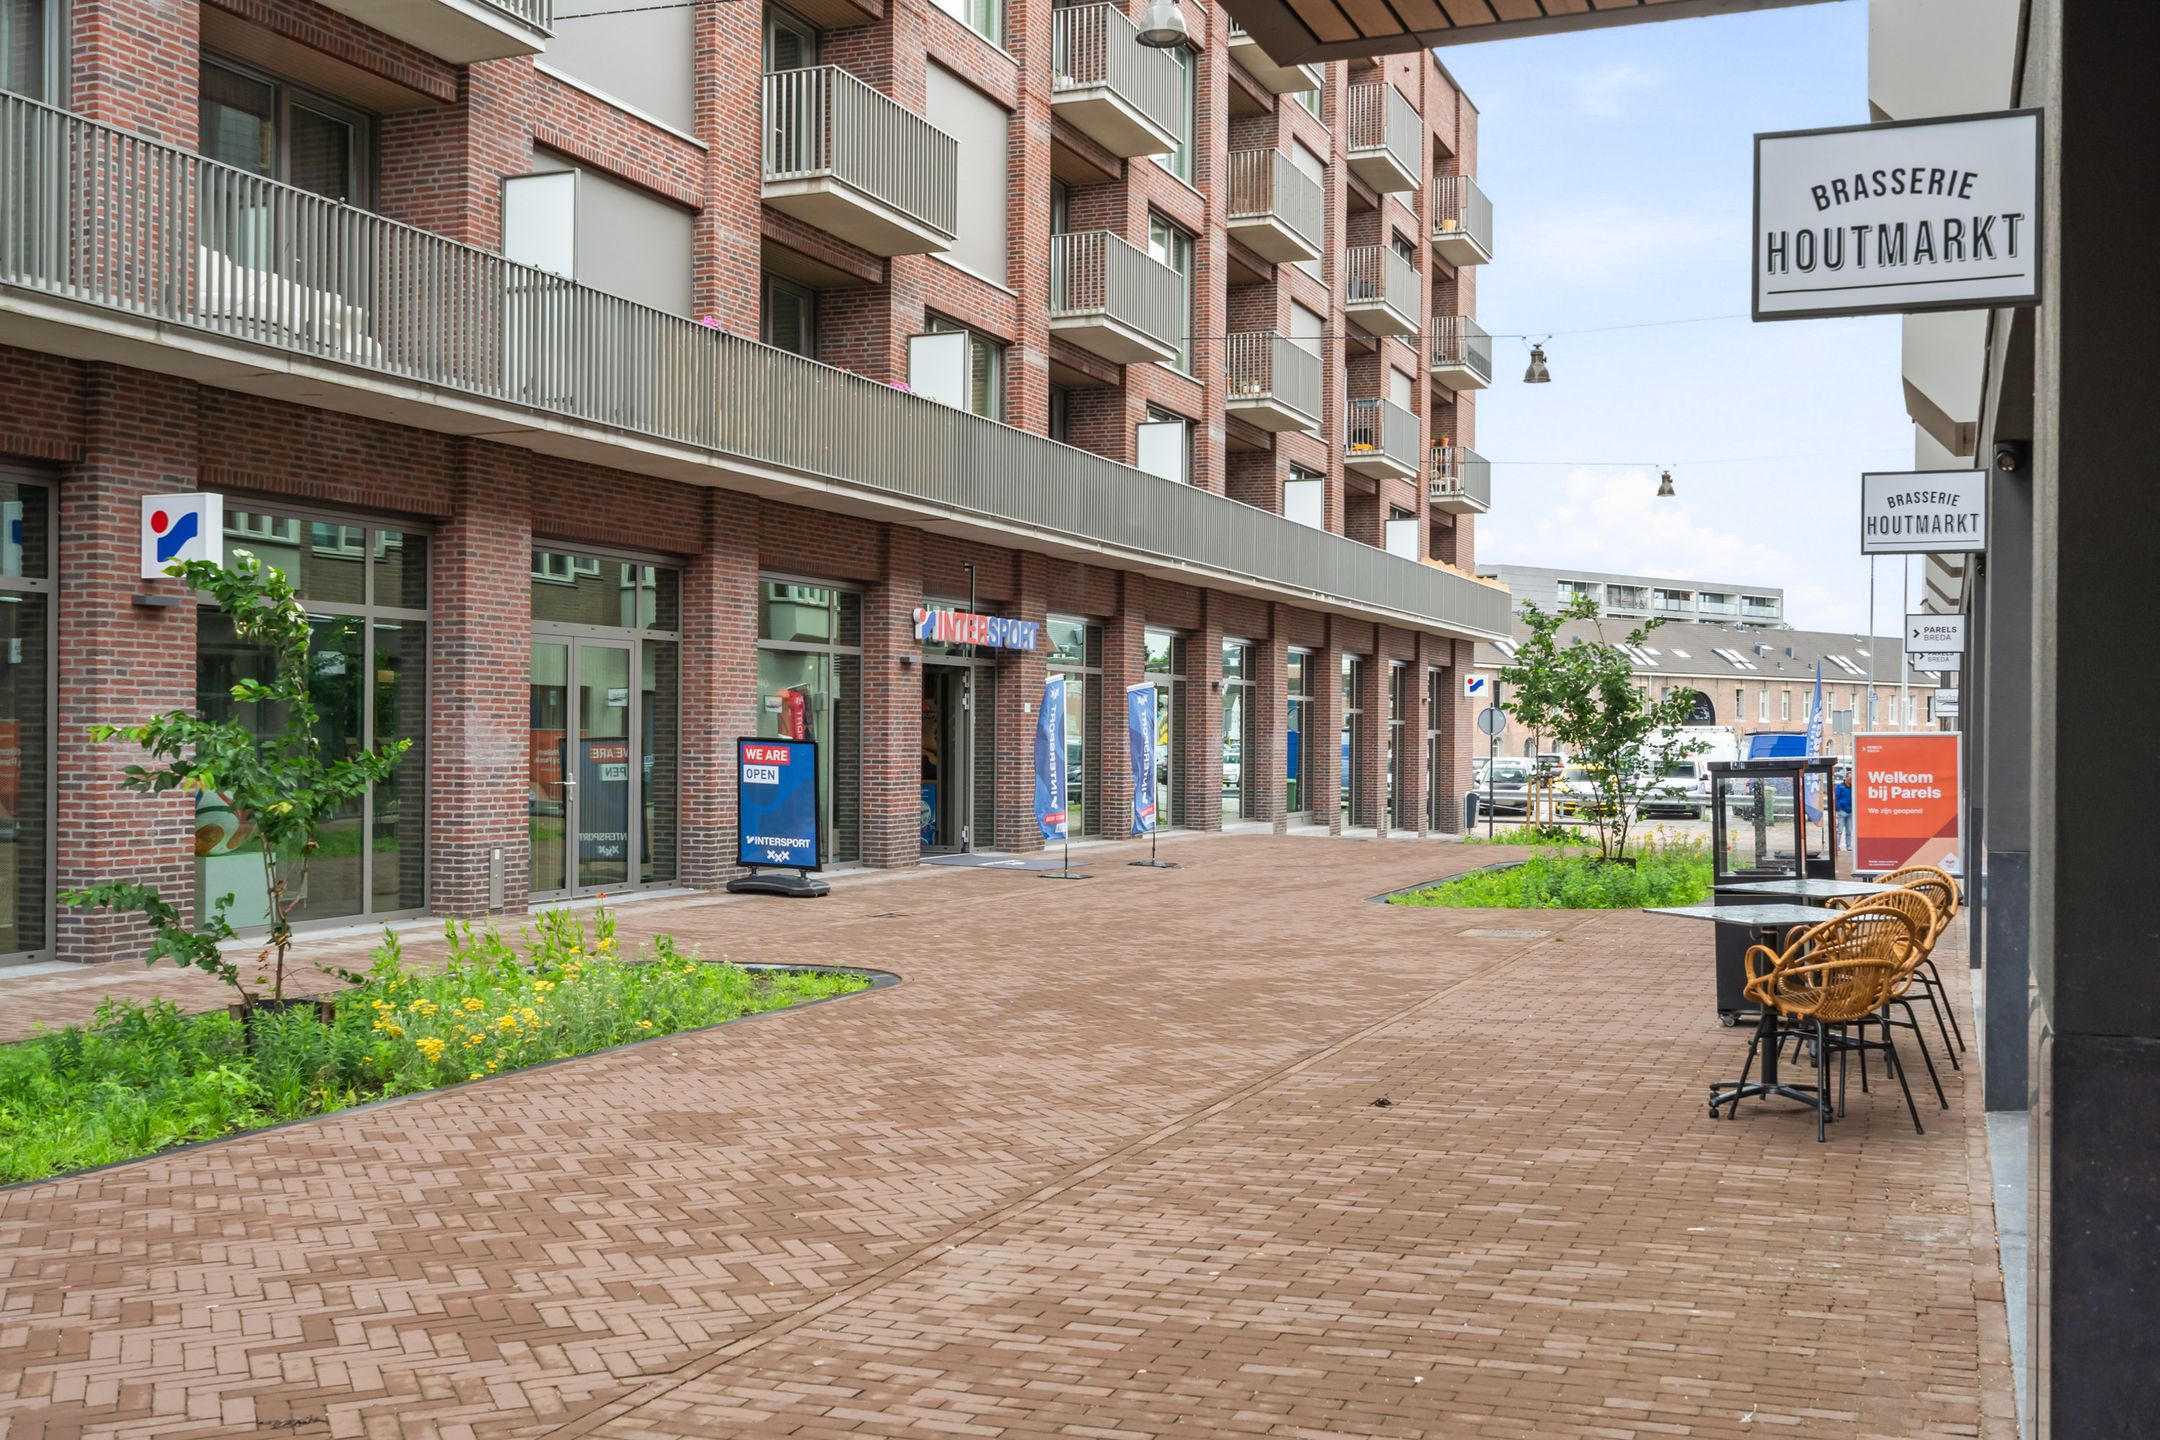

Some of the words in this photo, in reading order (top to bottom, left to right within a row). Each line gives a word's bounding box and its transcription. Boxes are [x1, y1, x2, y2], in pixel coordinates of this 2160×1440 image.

[1810, 167, 1979, 212] BRASSERIE
[1766, 212, 2025, 274] HOUTMARKT
[1887, 490, 1960, 509] BRASSERIE
[1867, 513, 1980, 536] HOUTMARKT
[937, 608, 1040, 652] INTERSPORT
[745, 748, 763, 760] WE
[765, 750, 788, 762] ARE
[746, 768, 776, 781] OPEN
[1868, 771, 1933, 784] Welkom
[1868, 786, 1888, 801] bij
[1891, 786, 1942, 799] Parels
[1880, 807, 1892, 815] zijn
[1893, 807, 1923, 815] geopend
[754, 836, 811, 848] INTERSPORT
